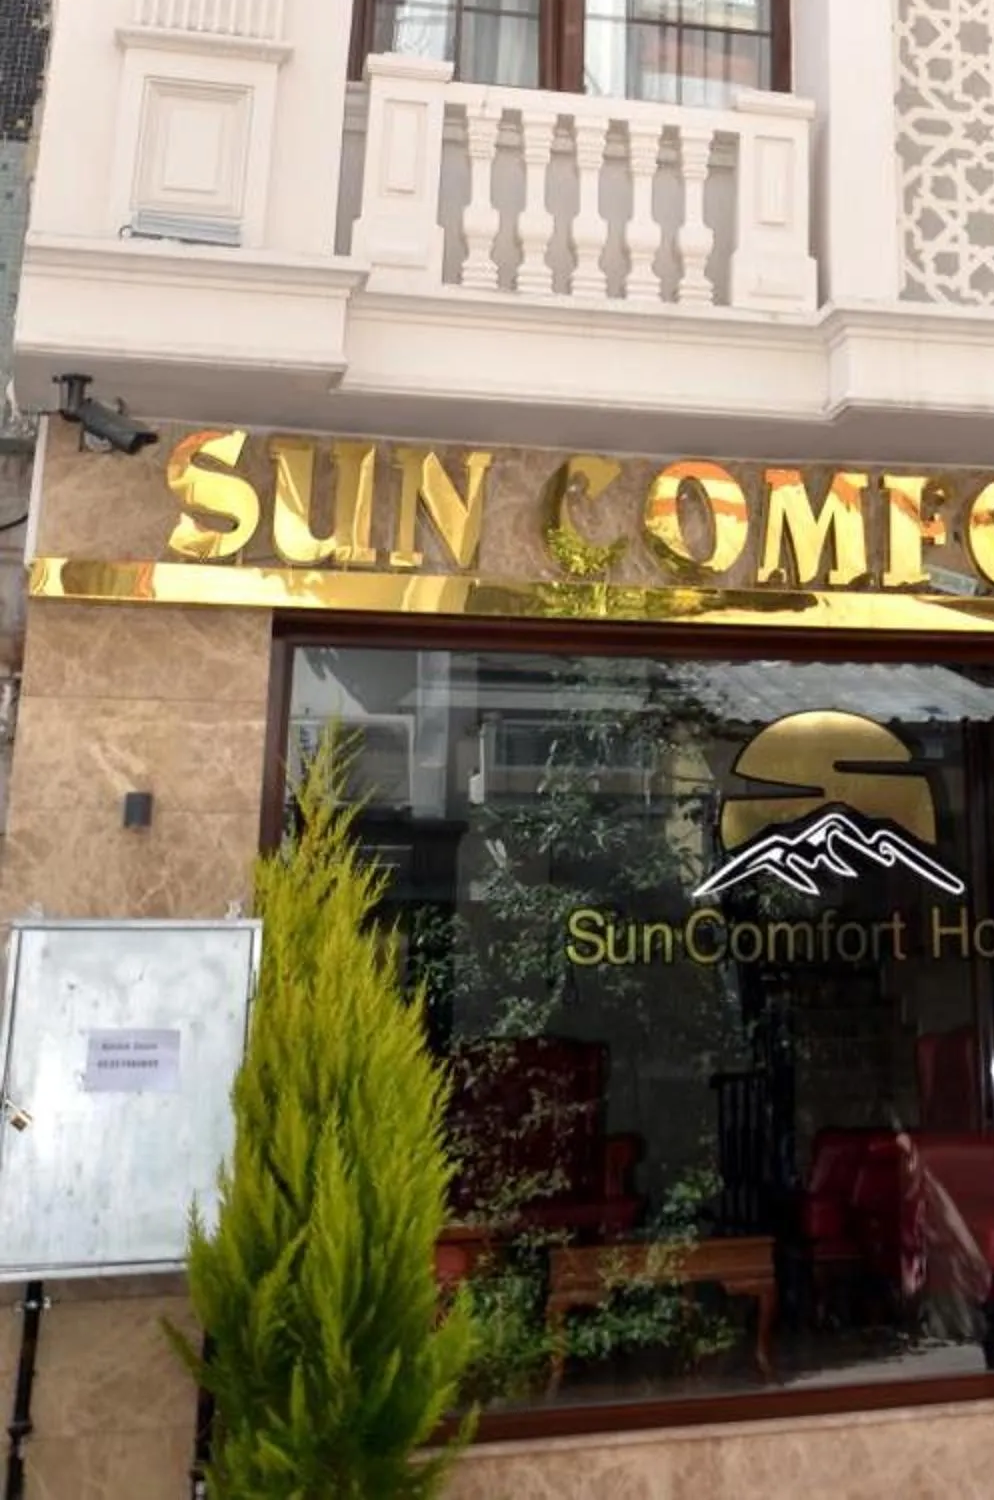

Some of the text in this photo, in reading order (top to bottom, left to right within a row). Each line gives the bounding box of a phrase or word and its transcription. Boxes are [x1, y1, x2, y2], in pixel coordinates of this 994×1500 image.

[167, 429, 492, 571] SUN
[566, 906, 674, 965] Sun
[685, 906, 907, 964] Comfort
